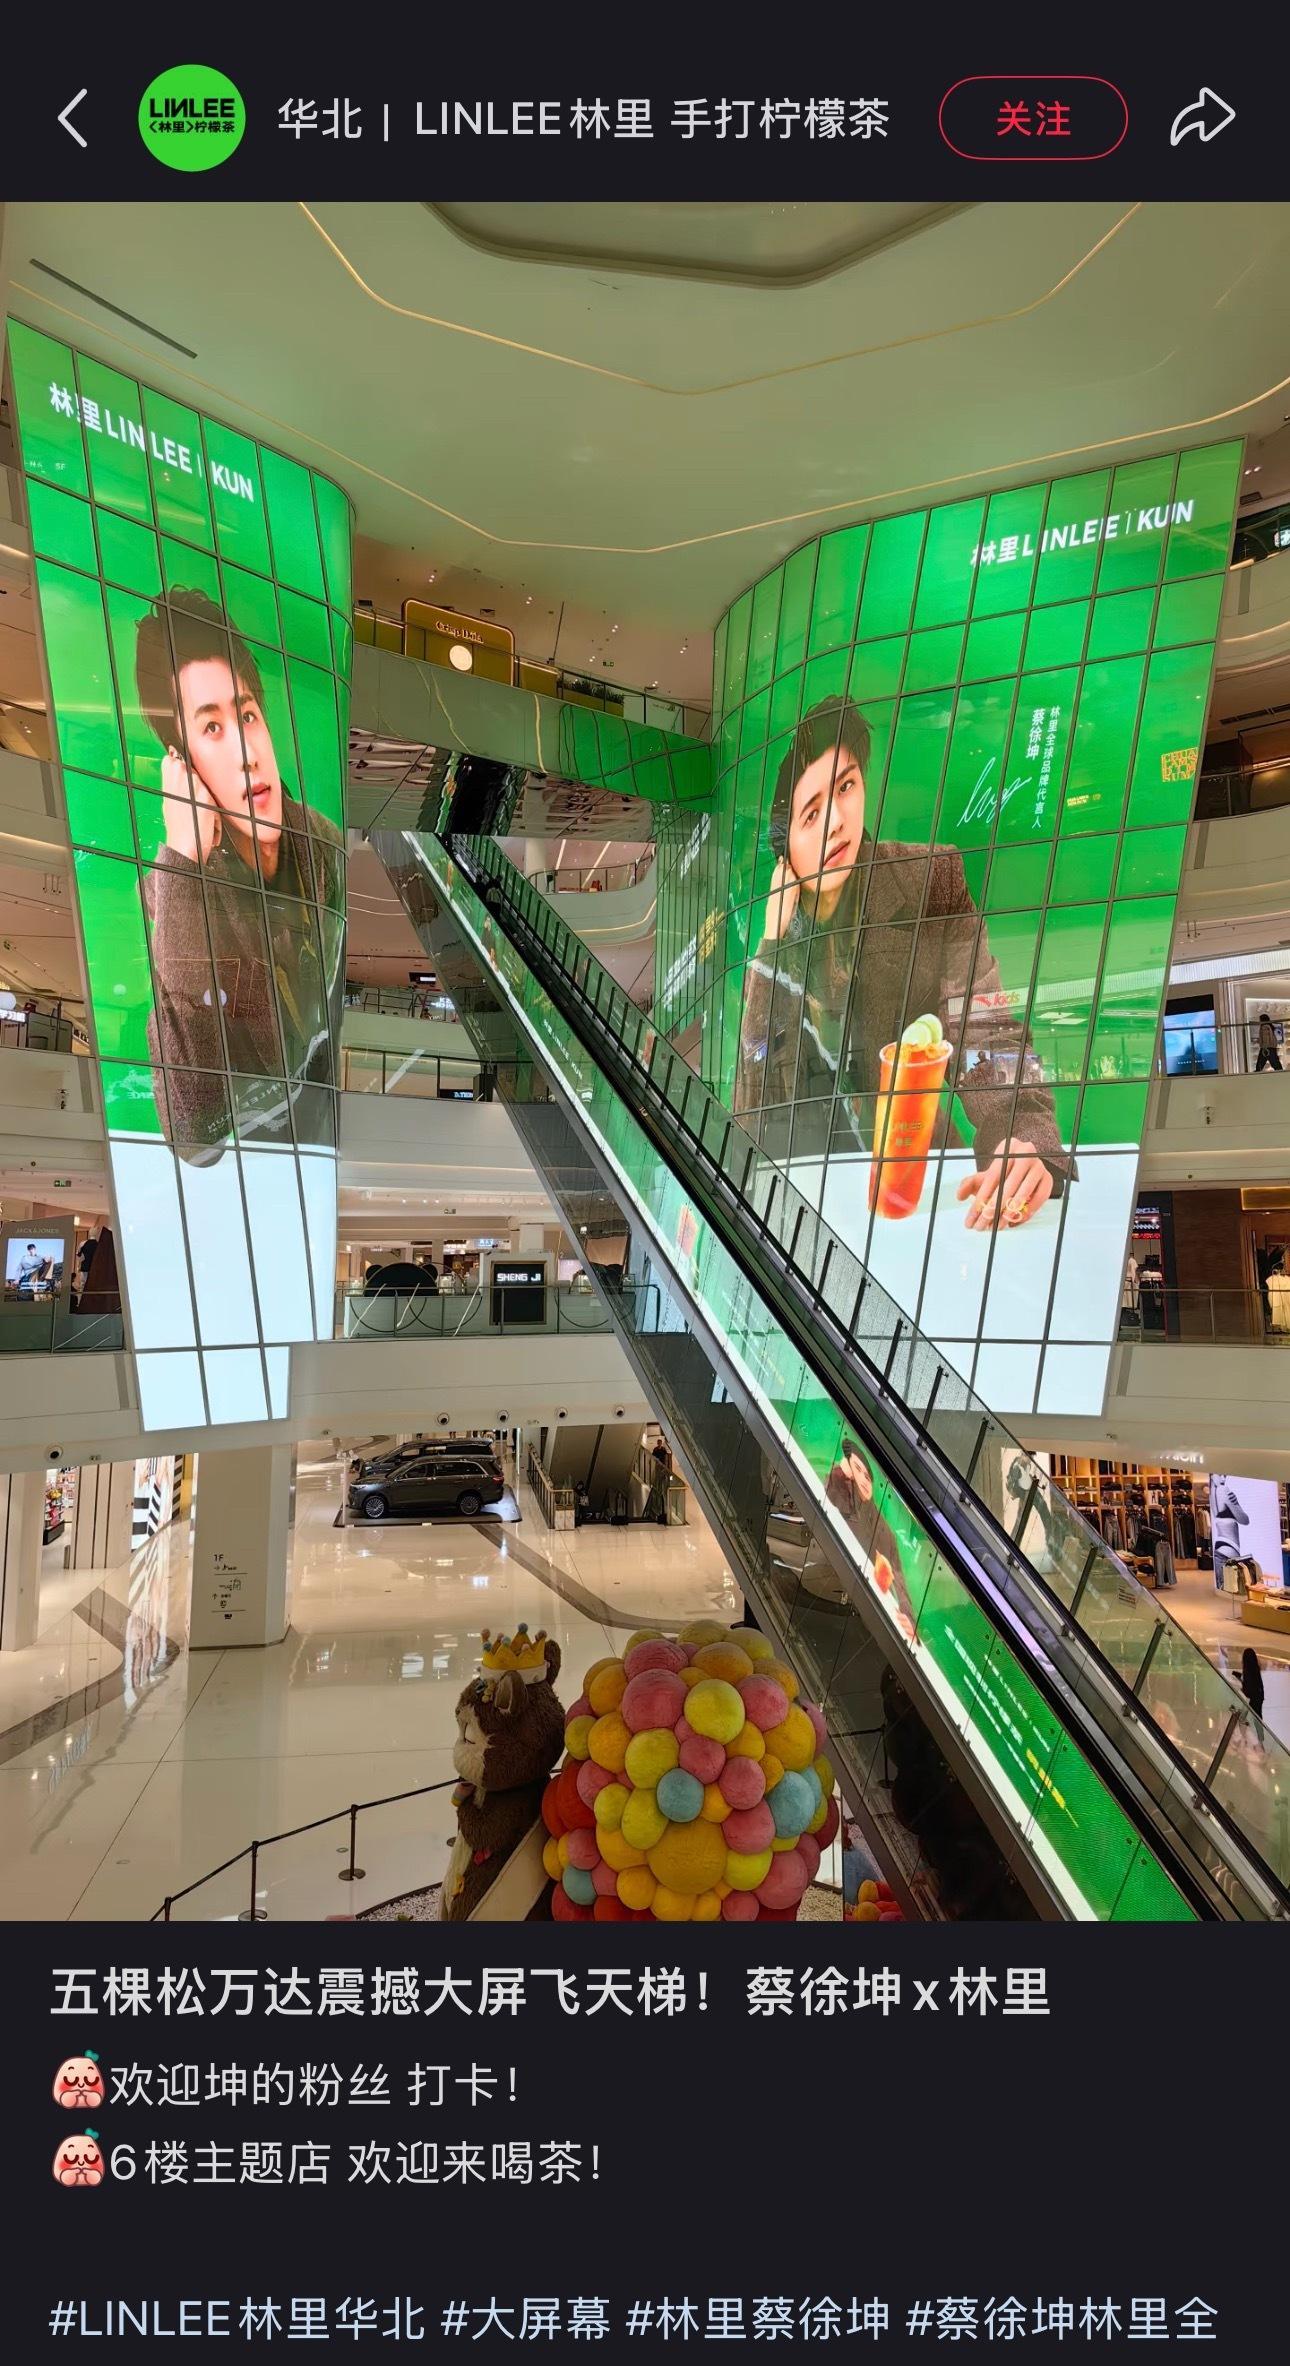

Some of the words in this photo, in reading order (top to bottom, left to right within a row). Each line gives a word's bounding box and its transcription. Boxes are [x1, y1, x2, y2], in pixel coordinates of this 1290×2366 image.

[211, 461, 255, 503] KUN
[1137, 499, 1195, 533] KUN
[1026, 708, 1046, 761] 蔡徐坤
[1031, 705, 1060, 829] 林里全球品牌代言人
[497, 1272, 528, 1282] SHENG
